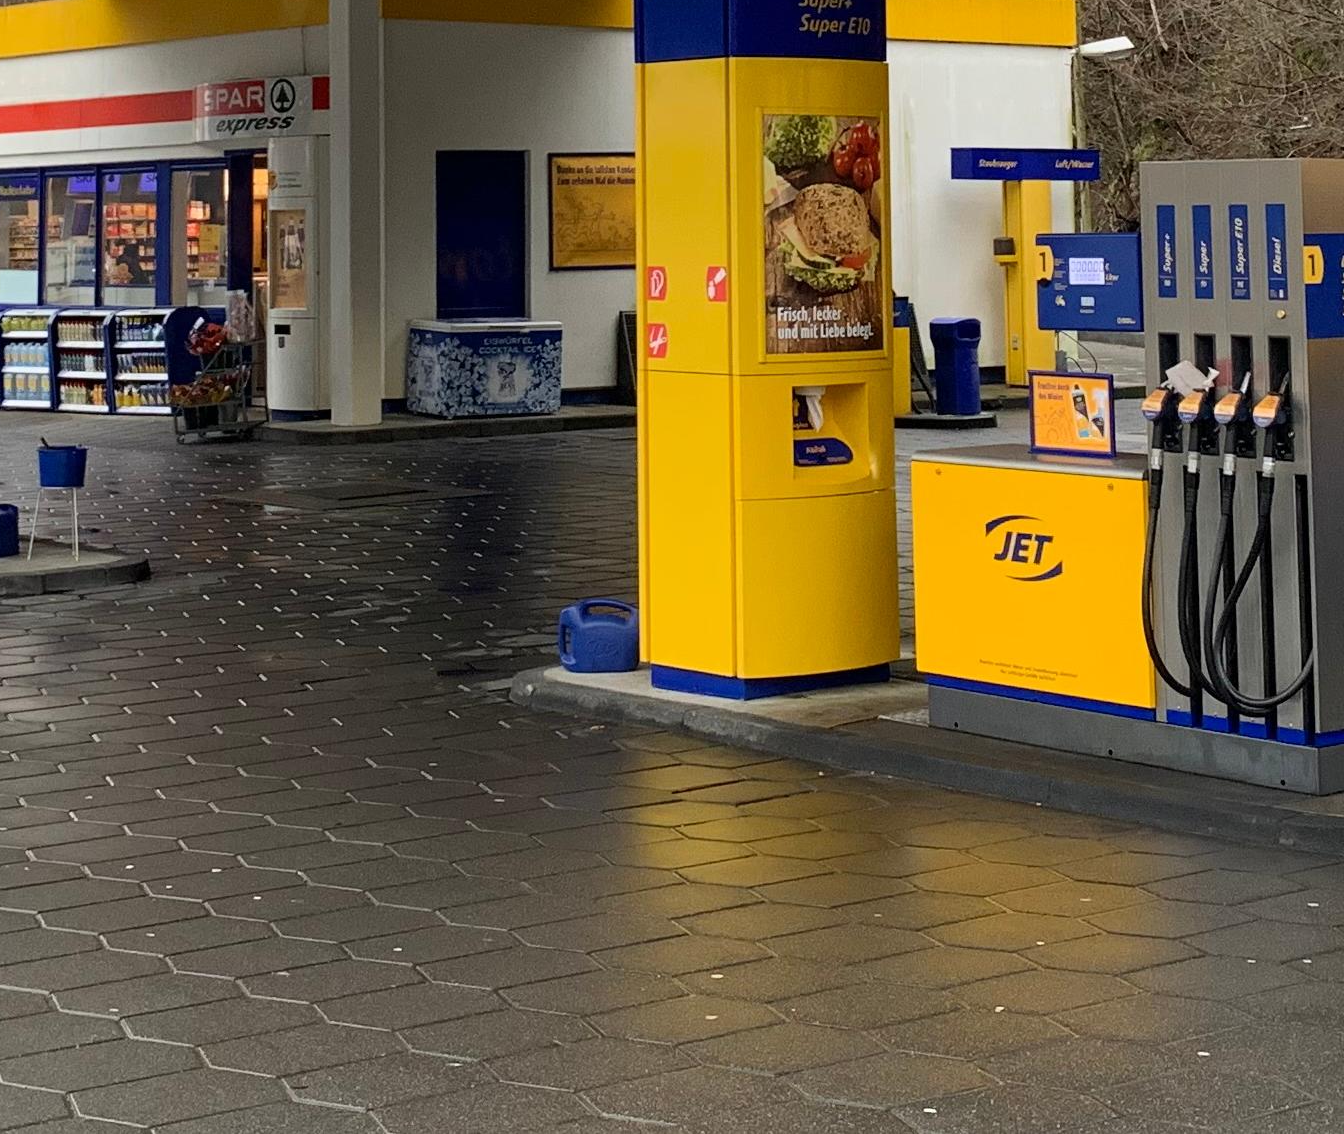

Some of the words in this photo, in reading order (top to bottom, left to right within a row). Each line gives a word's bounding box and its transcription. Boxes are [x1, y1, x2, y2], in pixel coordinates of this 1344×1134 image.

[798, 13, 846, 38] Super
[847, 17, 872, 35] E10
[203, 86, 264, 112] SPAR
[216, 115, 295, 135] express
[1234, 217, 1244, 239] E10
[1039, 251, 1046, 273] 1
[1162, 232, 1174, 275] Super+
[1199, 240, 1210, 275] Super
[1235, 240, 1247, 275] Super
[1271, 236, 1283, 275] Diesel
[1308, 253, 1316, 276] 1
[776, 306, 812, 323] Frisch,
[812, 306, 842, 321] lecker
[777, 324, 799, 339] und
[800, 323, 818, 338] mit
[819, 323, 846, 337] Liebe
[993, 531, 1054, 566] JET
